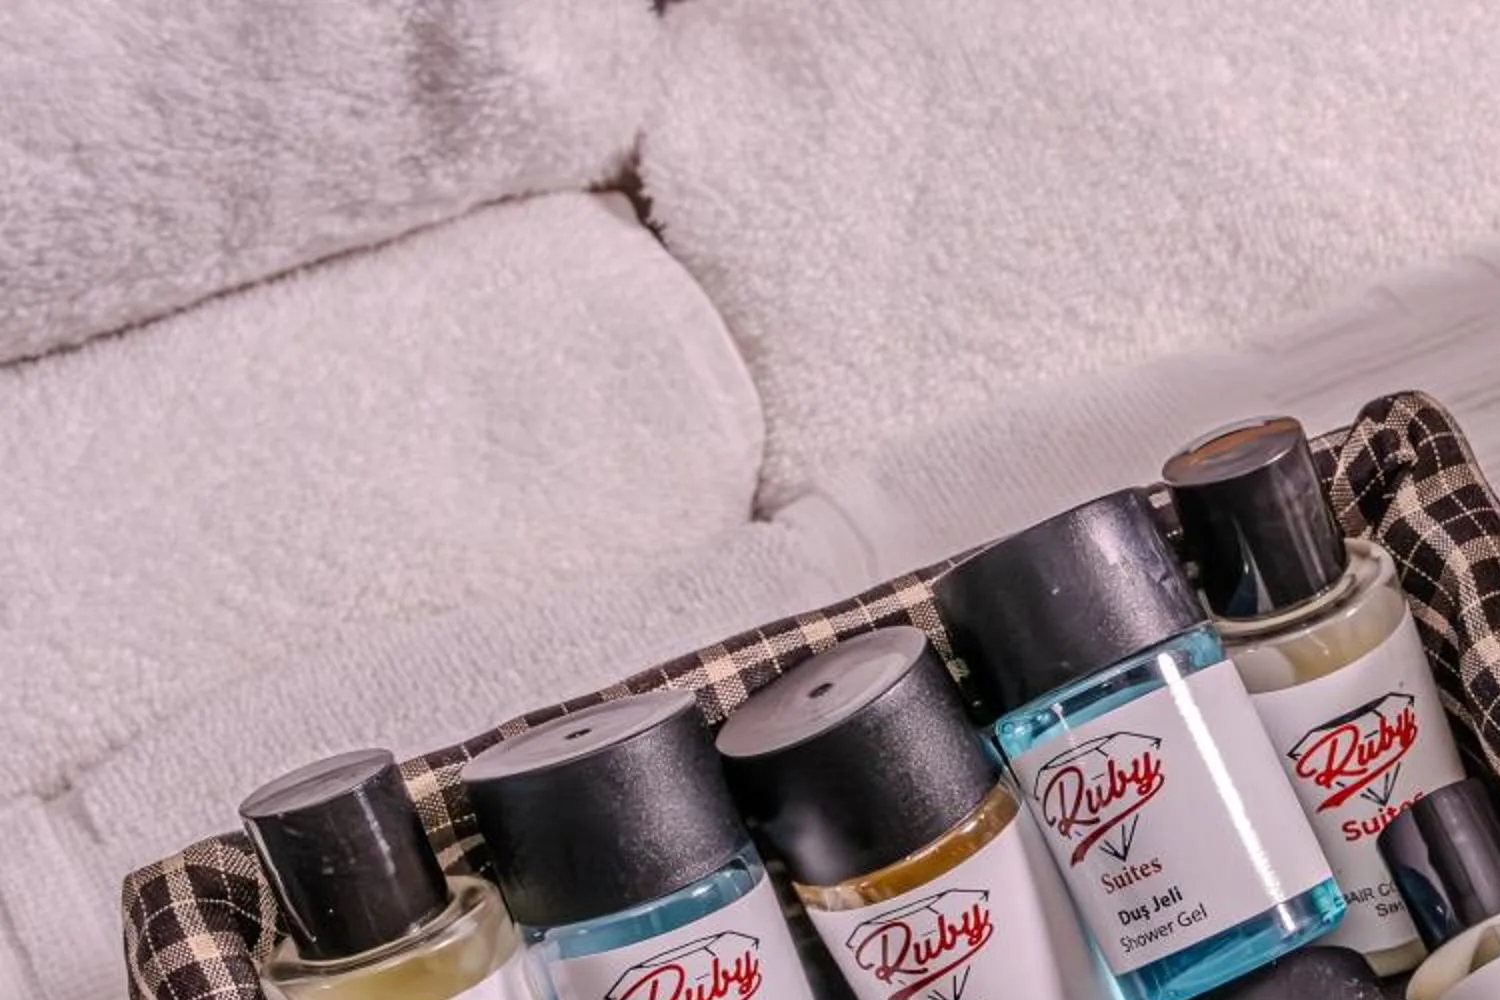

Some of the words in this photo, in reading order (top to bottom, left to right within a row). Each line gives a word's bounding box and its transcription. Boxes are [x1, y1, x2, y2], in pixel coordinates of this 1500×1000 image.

[1295, 706, 1418, 813] Ruby
[1043, 751, 1165, 869] Ruby
[1101, 857, 1162, 894] Suites
[1117, 903, 1150, 926] Duş
[1152, 885, 1183, 912] Jeli
[1119, 922, 1174, 953] Shower
[1177, 902, 1208, 928] Gel
